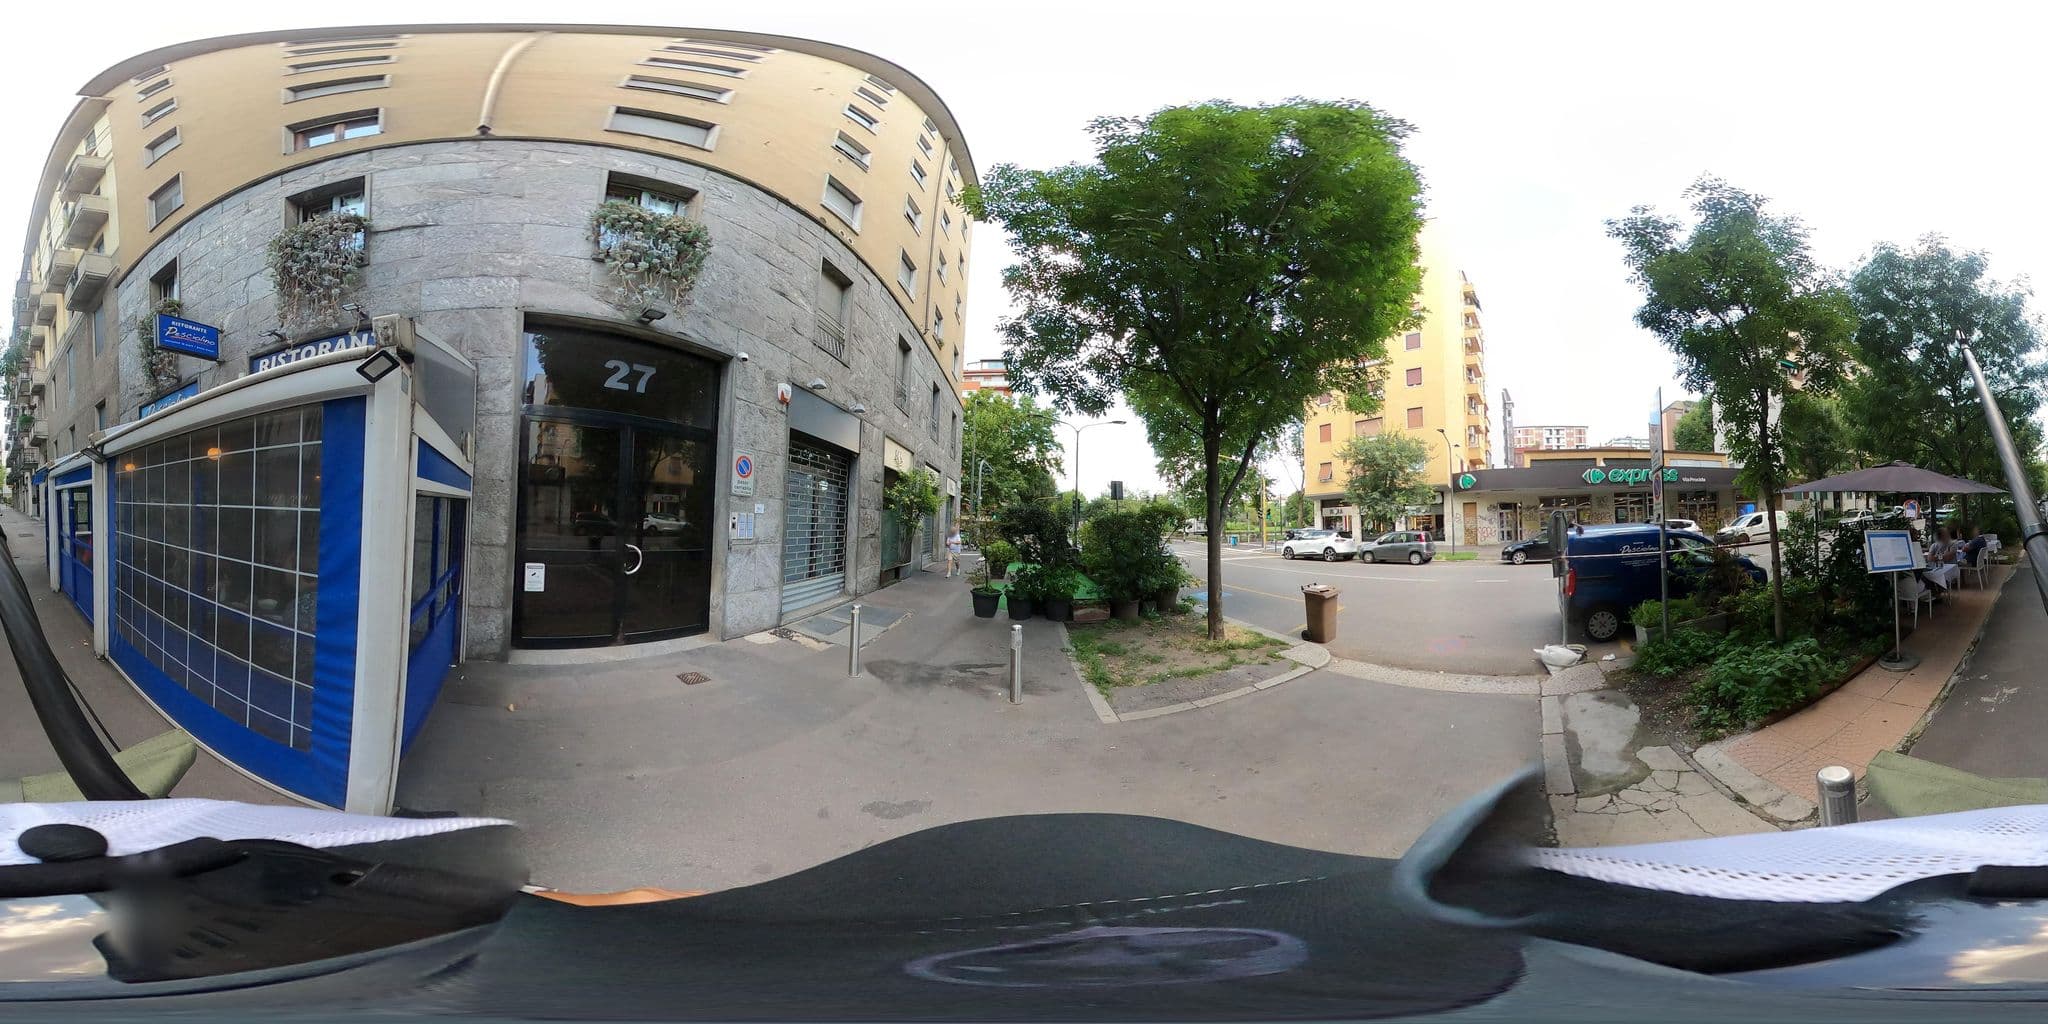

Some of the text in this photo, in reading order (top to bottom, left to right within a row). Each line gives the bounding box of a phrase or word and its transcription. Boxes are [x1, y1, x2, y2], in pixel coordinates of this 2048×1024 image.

[164, 326, 215, 346] Pesciolino
[171, 321, 207, 334] RISTORANTE
[259, 332, 376, 372] RISTORAN
[604, 359, 657, 394] 27
